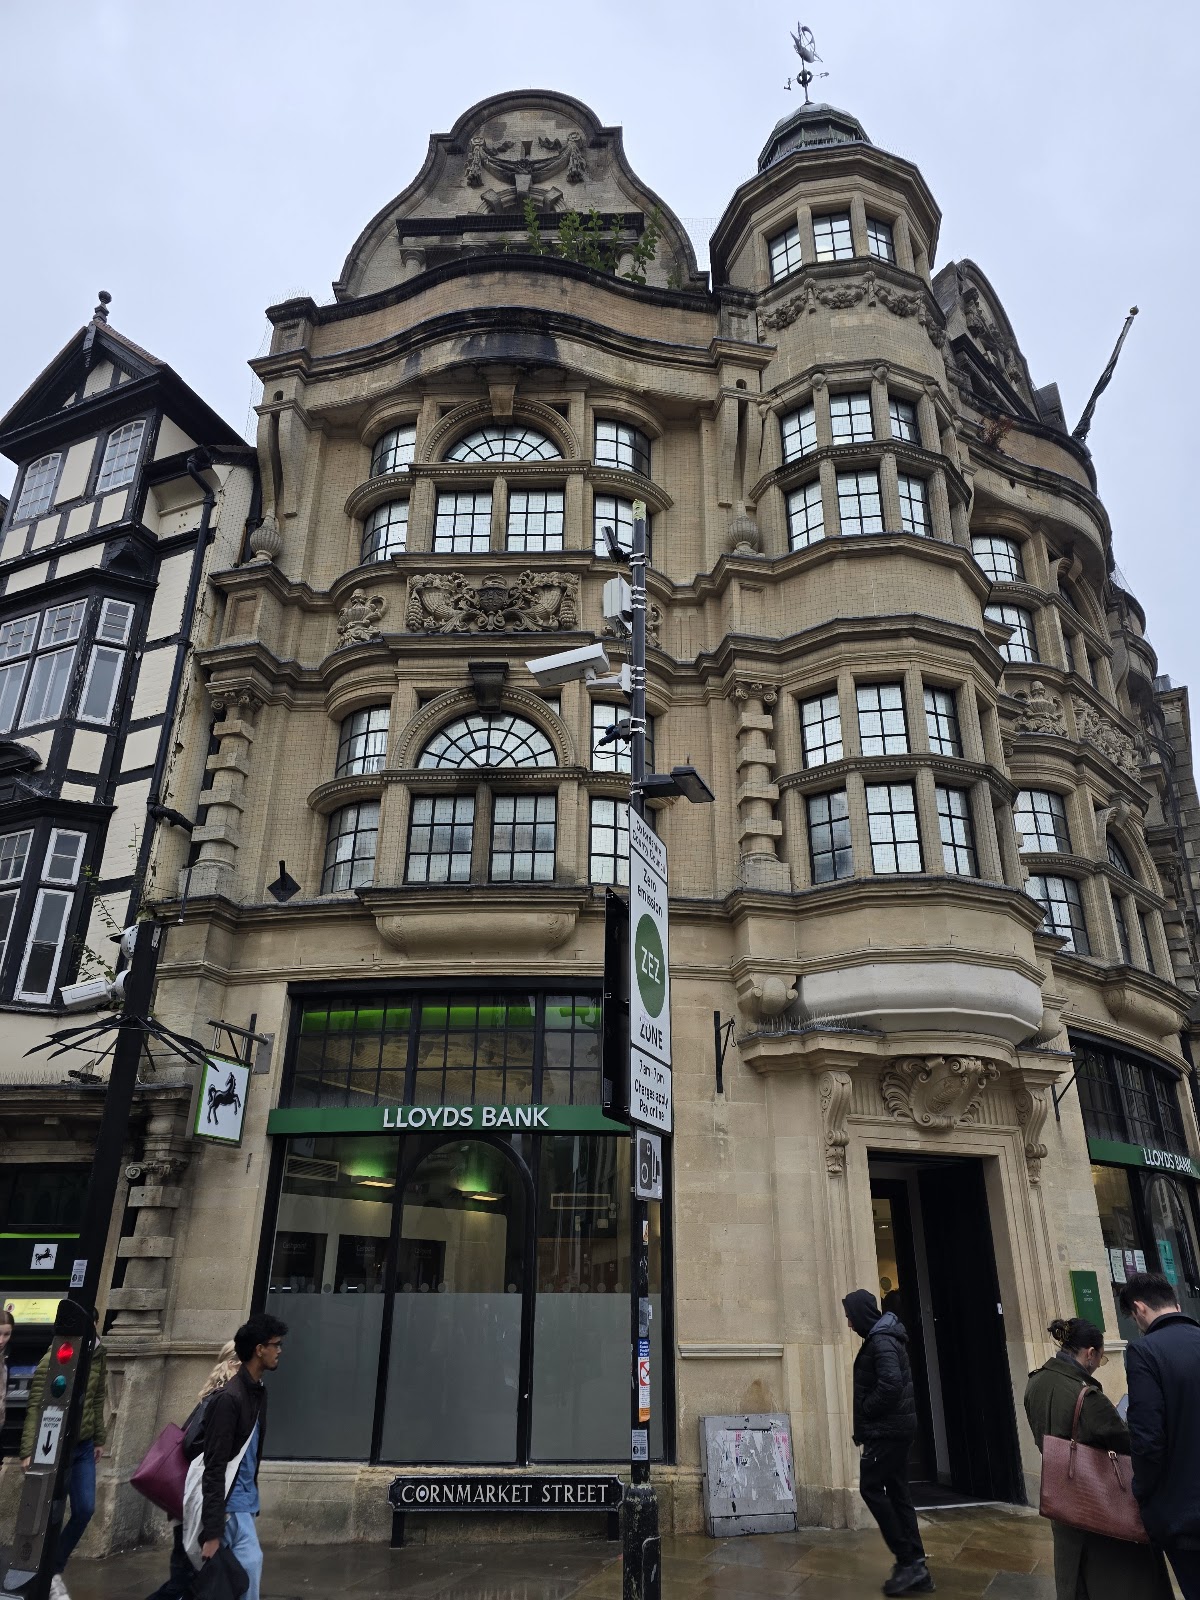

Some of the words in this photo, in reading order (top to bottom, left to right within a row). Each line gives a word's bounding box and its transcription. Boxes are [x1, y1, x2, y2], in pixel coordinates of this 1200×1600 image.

[632, 829, 649, 857] County
[649, 849, 666, 876] Council
[643, 868, 657, 893] Zero
[637, 884, 663, 918] emission
[641, 945, 661, 985] ZEZ
[639, 1016, 663, 1051] ZONE
[634, 1078, 655, 1101] Charges
[655, 1092, 669, 1109] apply
[383, 1106, 474, 1128] LLOYDS
[481, 1106, 550, 1128] BANK
[639, 1098, 649, 1117] Pay
[649, 1105, 665, 1121] online
[1142, 1147, 1175, 1170] LLOYDS
[1173, 1154, 1194, 1174] BANK
[401, 1484, 533, 1504] CORNMARKET
[541, 1484, 609, 1503] STREET
